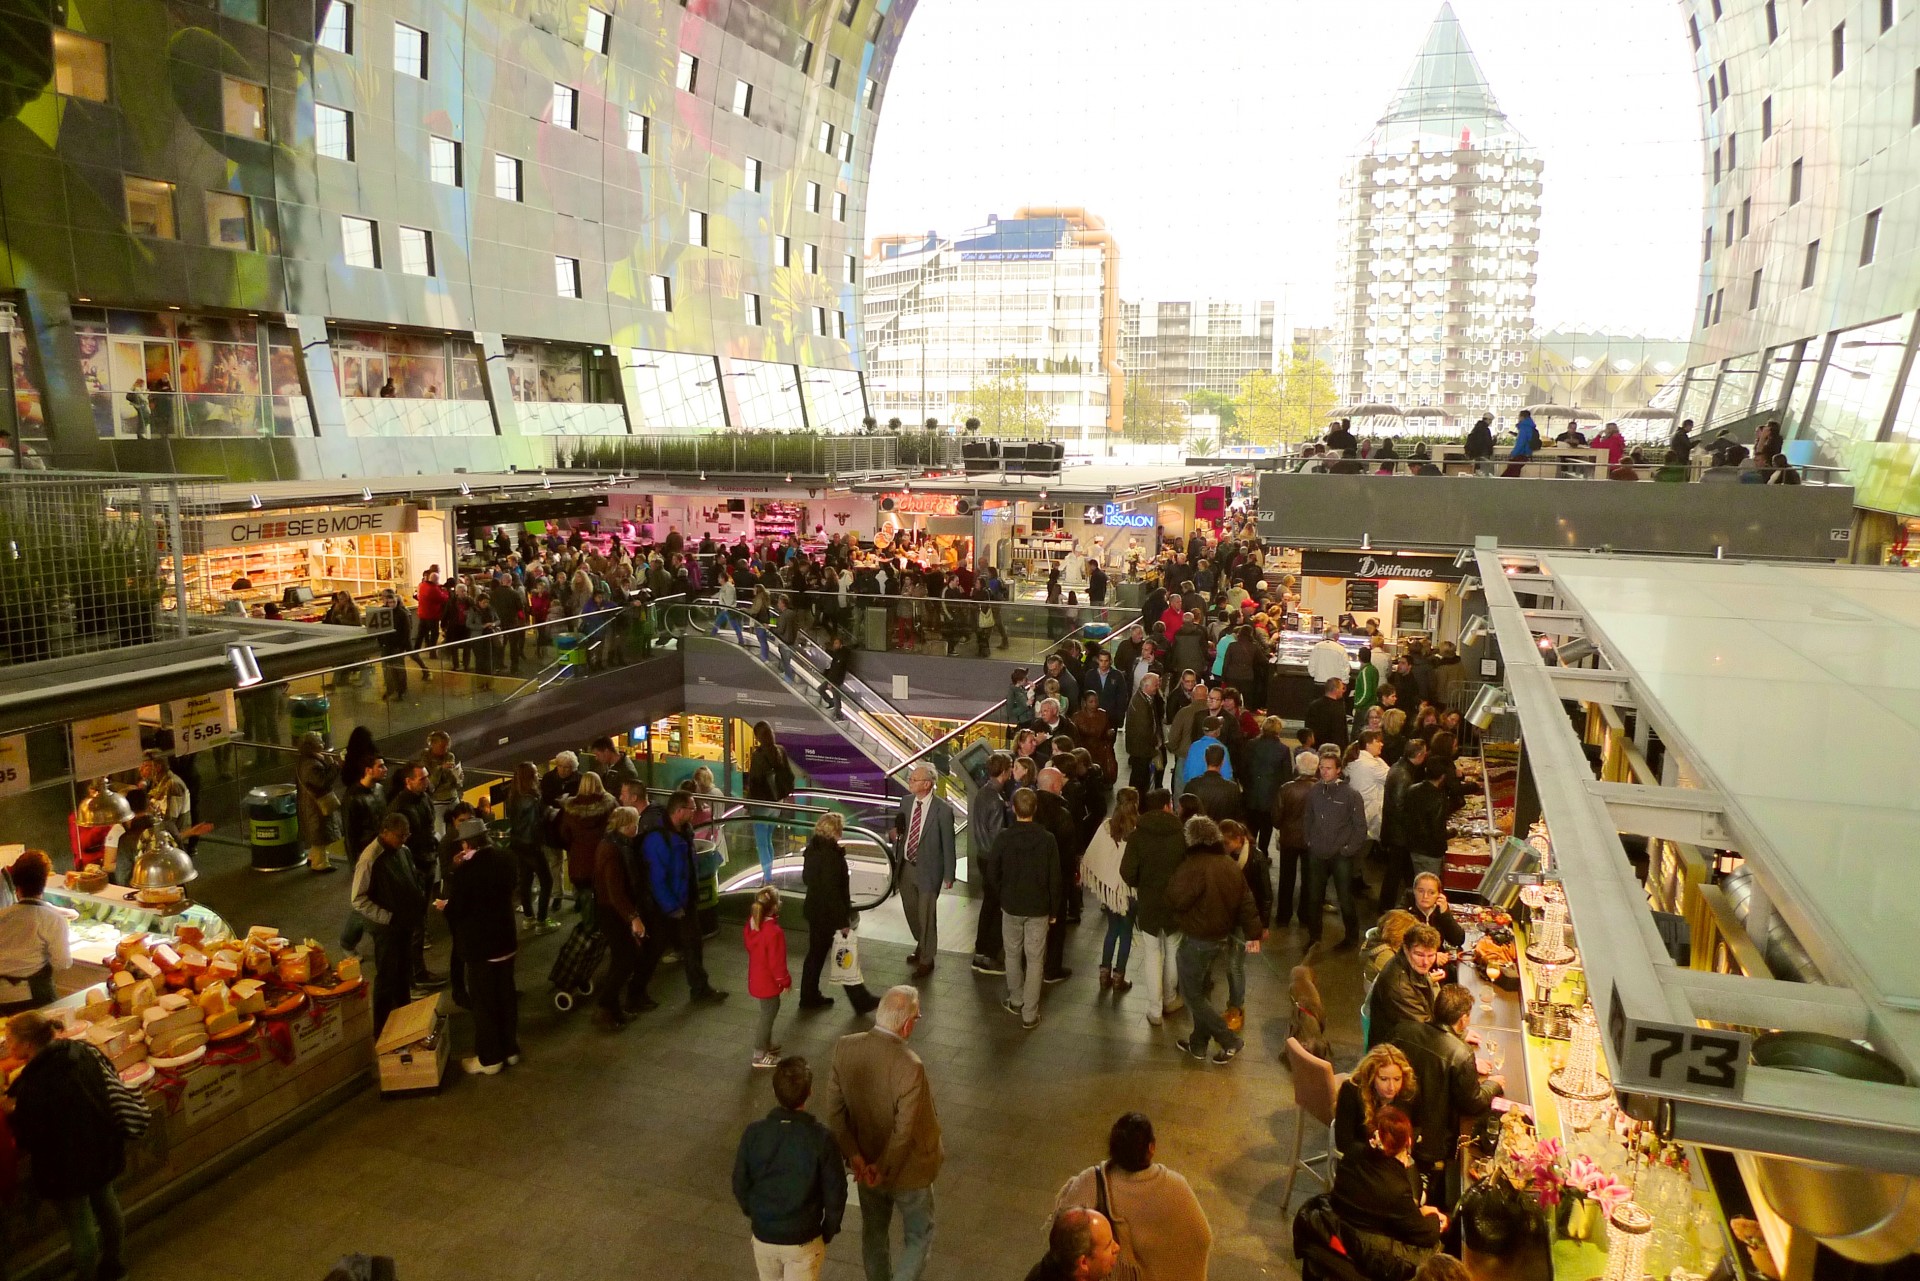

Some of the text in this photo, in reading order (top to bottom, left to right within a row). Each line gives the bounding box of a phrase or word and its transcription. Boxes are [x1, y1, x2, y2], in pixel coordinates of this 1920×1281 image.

[1104, 514, 1154, 527] IJSSALON
[1259, 511, 1274, 520] 77
[231, 513, 383, 542] CHEESE & MORE
[1831, 530, 1849, 540] 79
[1355, 555, 1434, 578] Délifrance
[369, 610, 391, 629] 48
[194, 723, 222, 740] 5,95
[1635, 1026, 1740, 1089] 73
